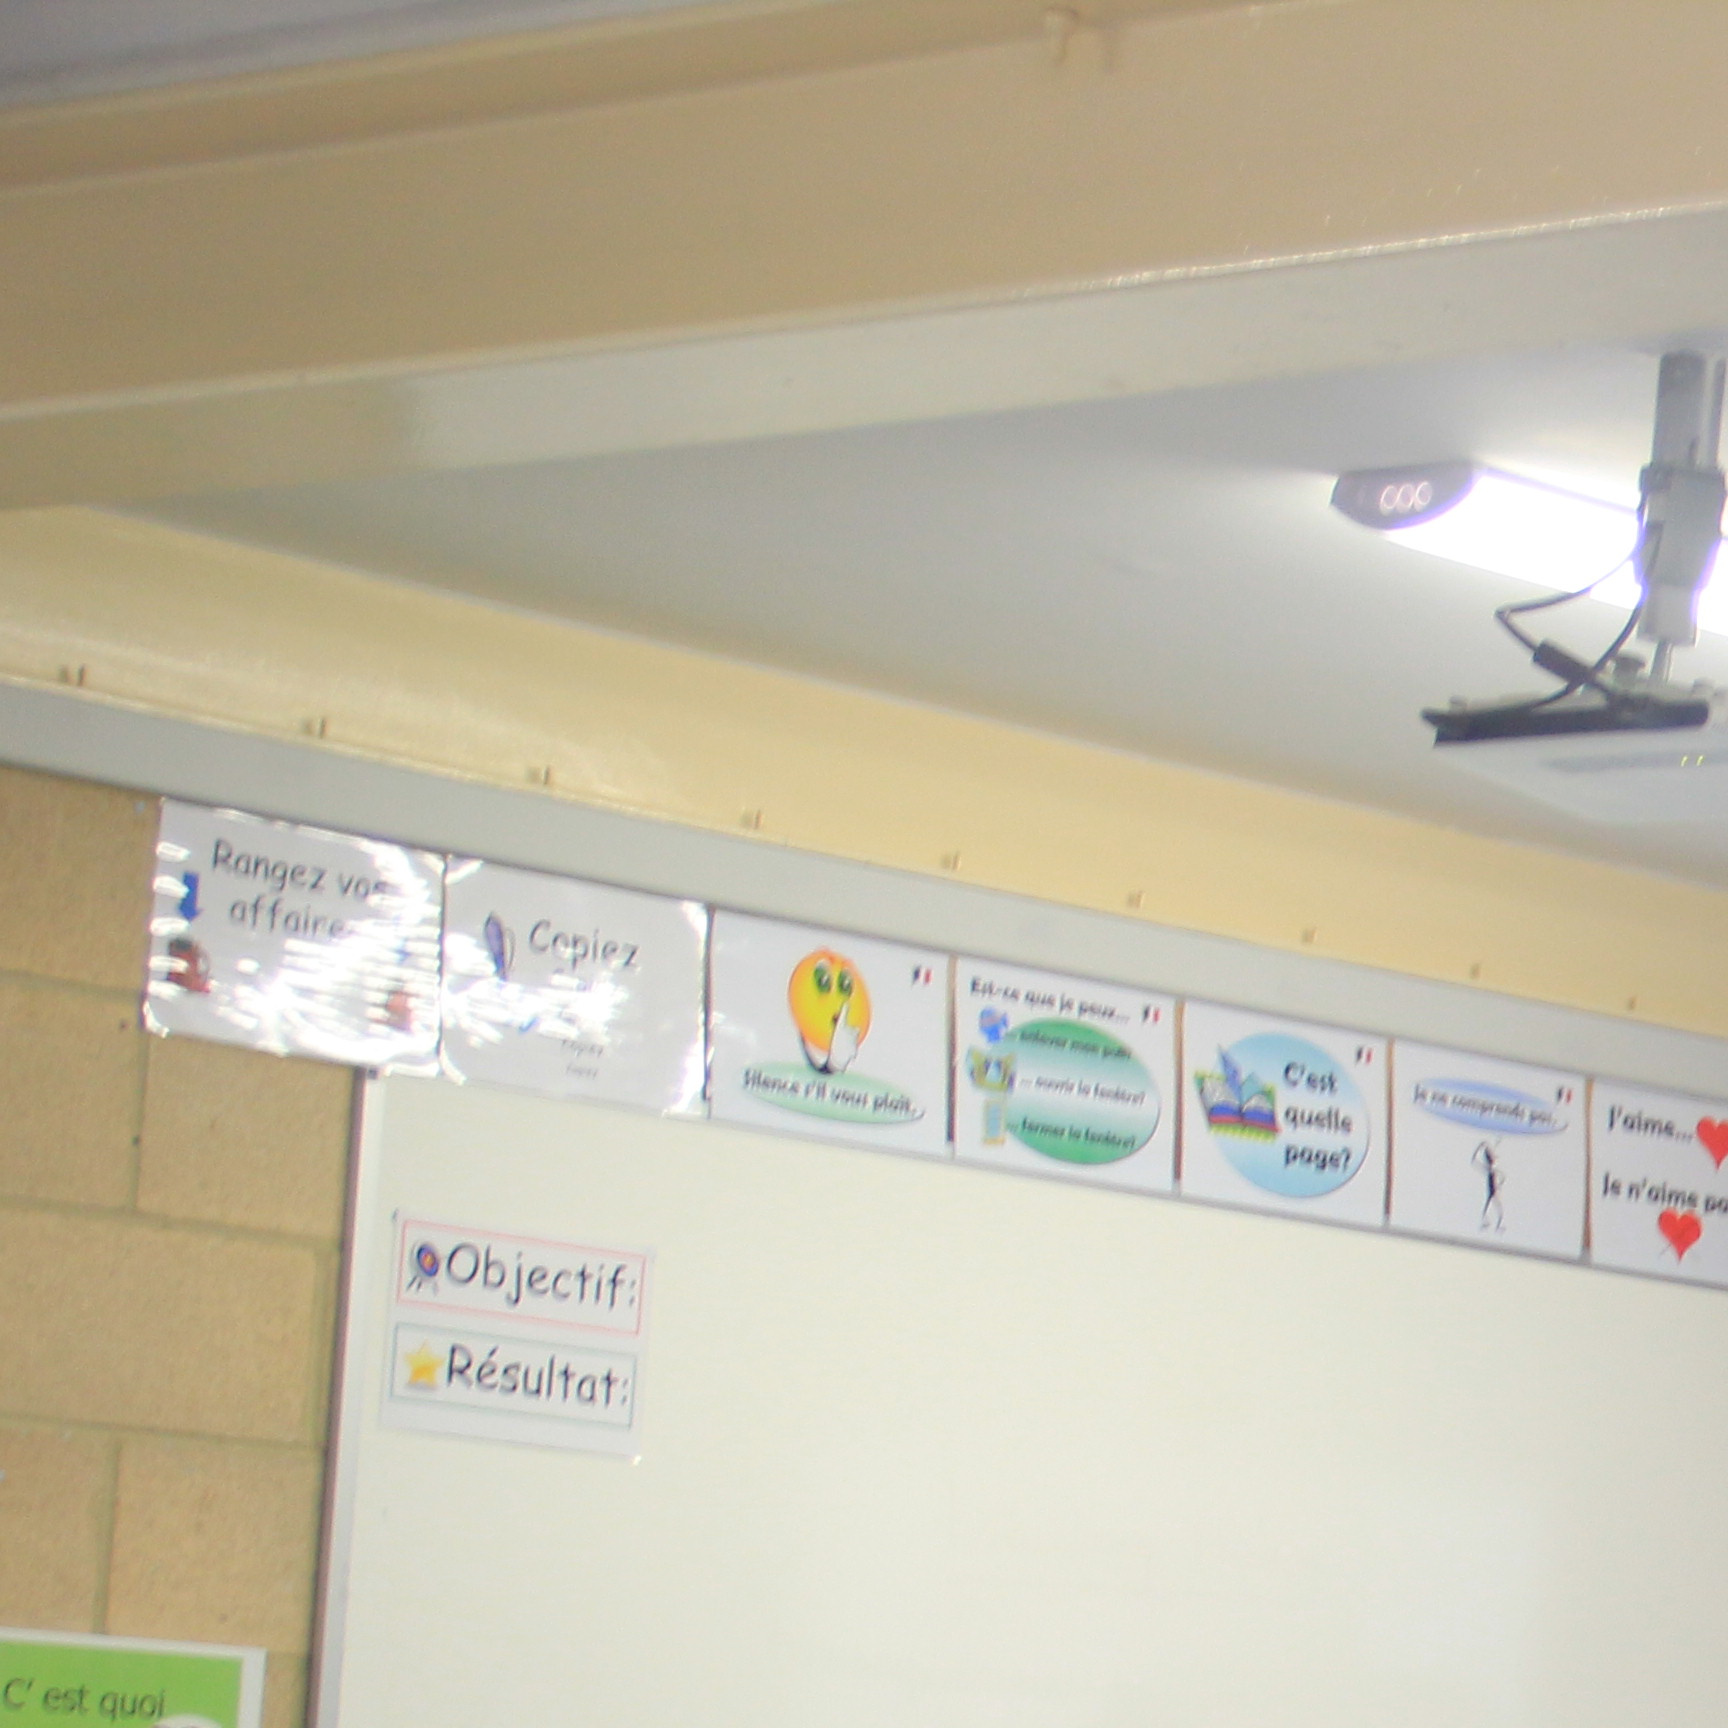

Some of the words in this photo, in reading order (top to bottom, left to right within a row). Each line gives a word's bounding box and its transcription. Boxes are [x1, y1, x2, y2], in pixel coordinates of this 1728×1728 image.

[211, 838, 328, 892] Rangez
[229, 895, 356, 940] affaire
[529, 918, 640, 970] Copiez
[1024, 990, 1056, 1010] que
[1283, 1060, 1338, 1094] C'est
[1283, 1105, 1353, 1134] quelle
[1283, 1144, 1353, 1173] page?
[1602, 1170, 1622, 1197] Je
[1626, 1177, 1700, 1210] n'aime
[99, 1688, 167, 1723] quoi
